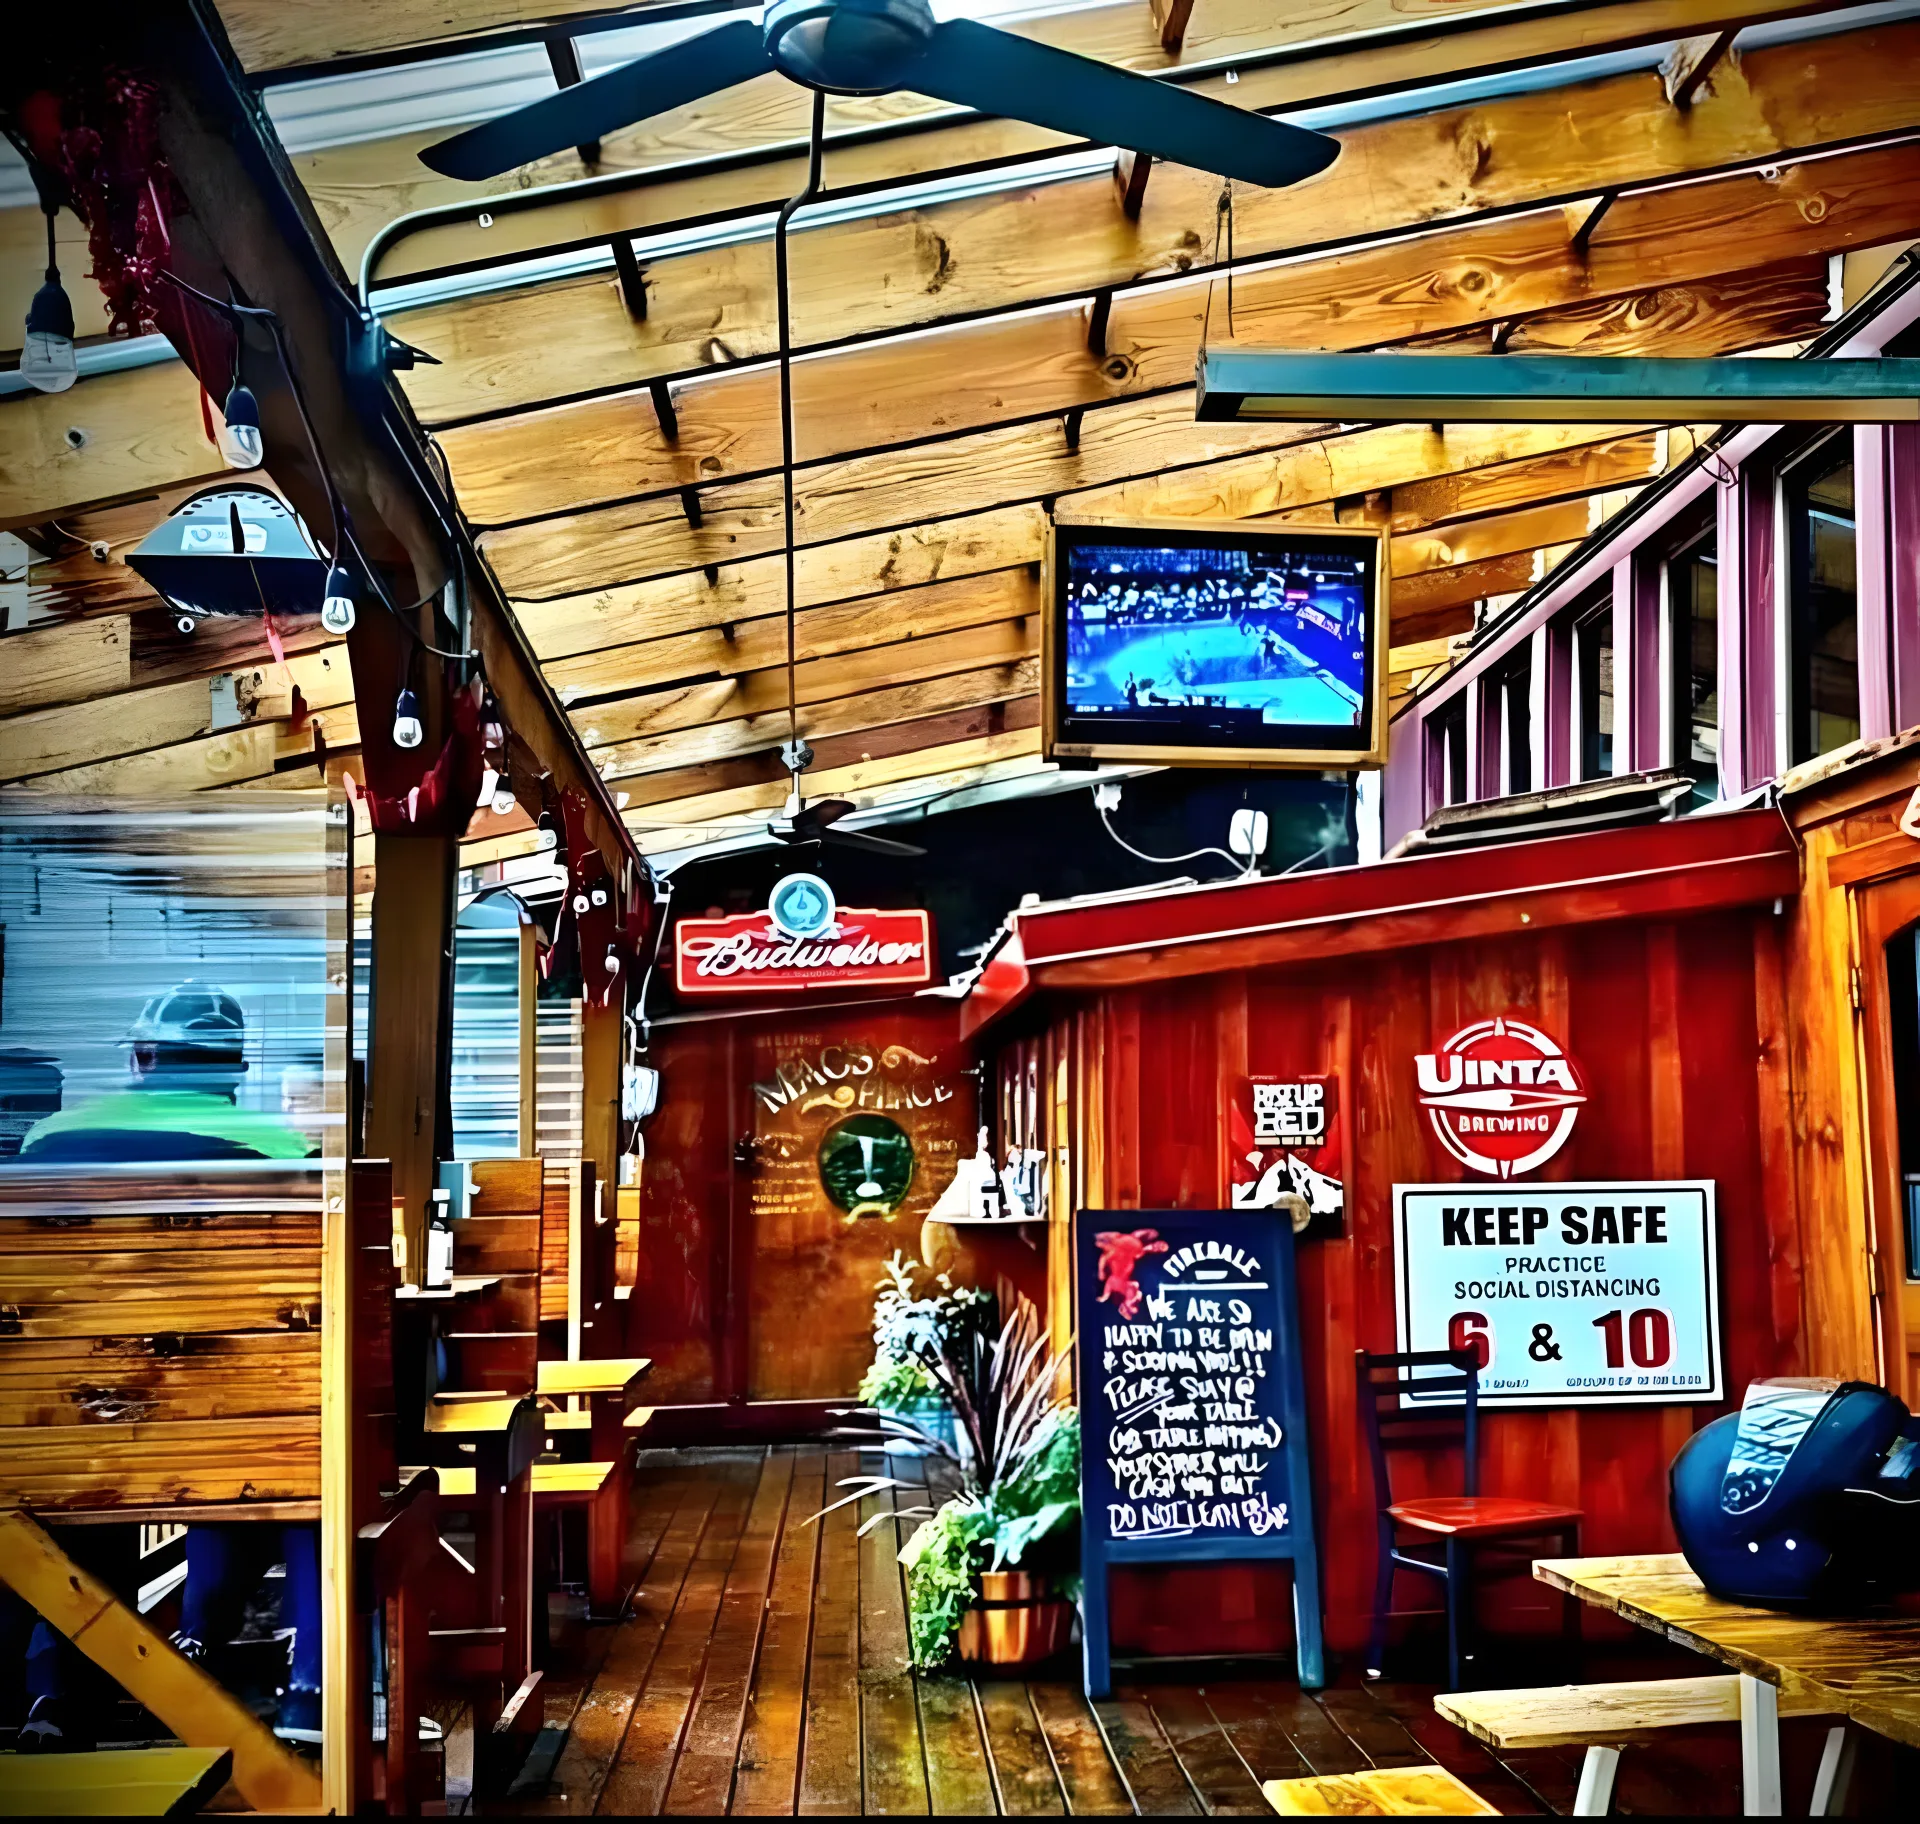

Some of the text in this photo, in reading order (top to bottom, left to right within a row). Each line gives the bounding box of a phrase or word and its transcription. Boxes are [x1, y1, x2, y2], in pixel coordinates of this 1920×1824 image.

[1414, 1054, 1578, 1093] UINTA
[1442, 1205, 1667, 1246] KEEP SAFE
[1505, 1256, 1606, 1273] PRACTICE
[1454, 1278, 1660, 1299] SOCIAL DISTANCING
[1448, 1308, 1671, 1372] 6 & 10
